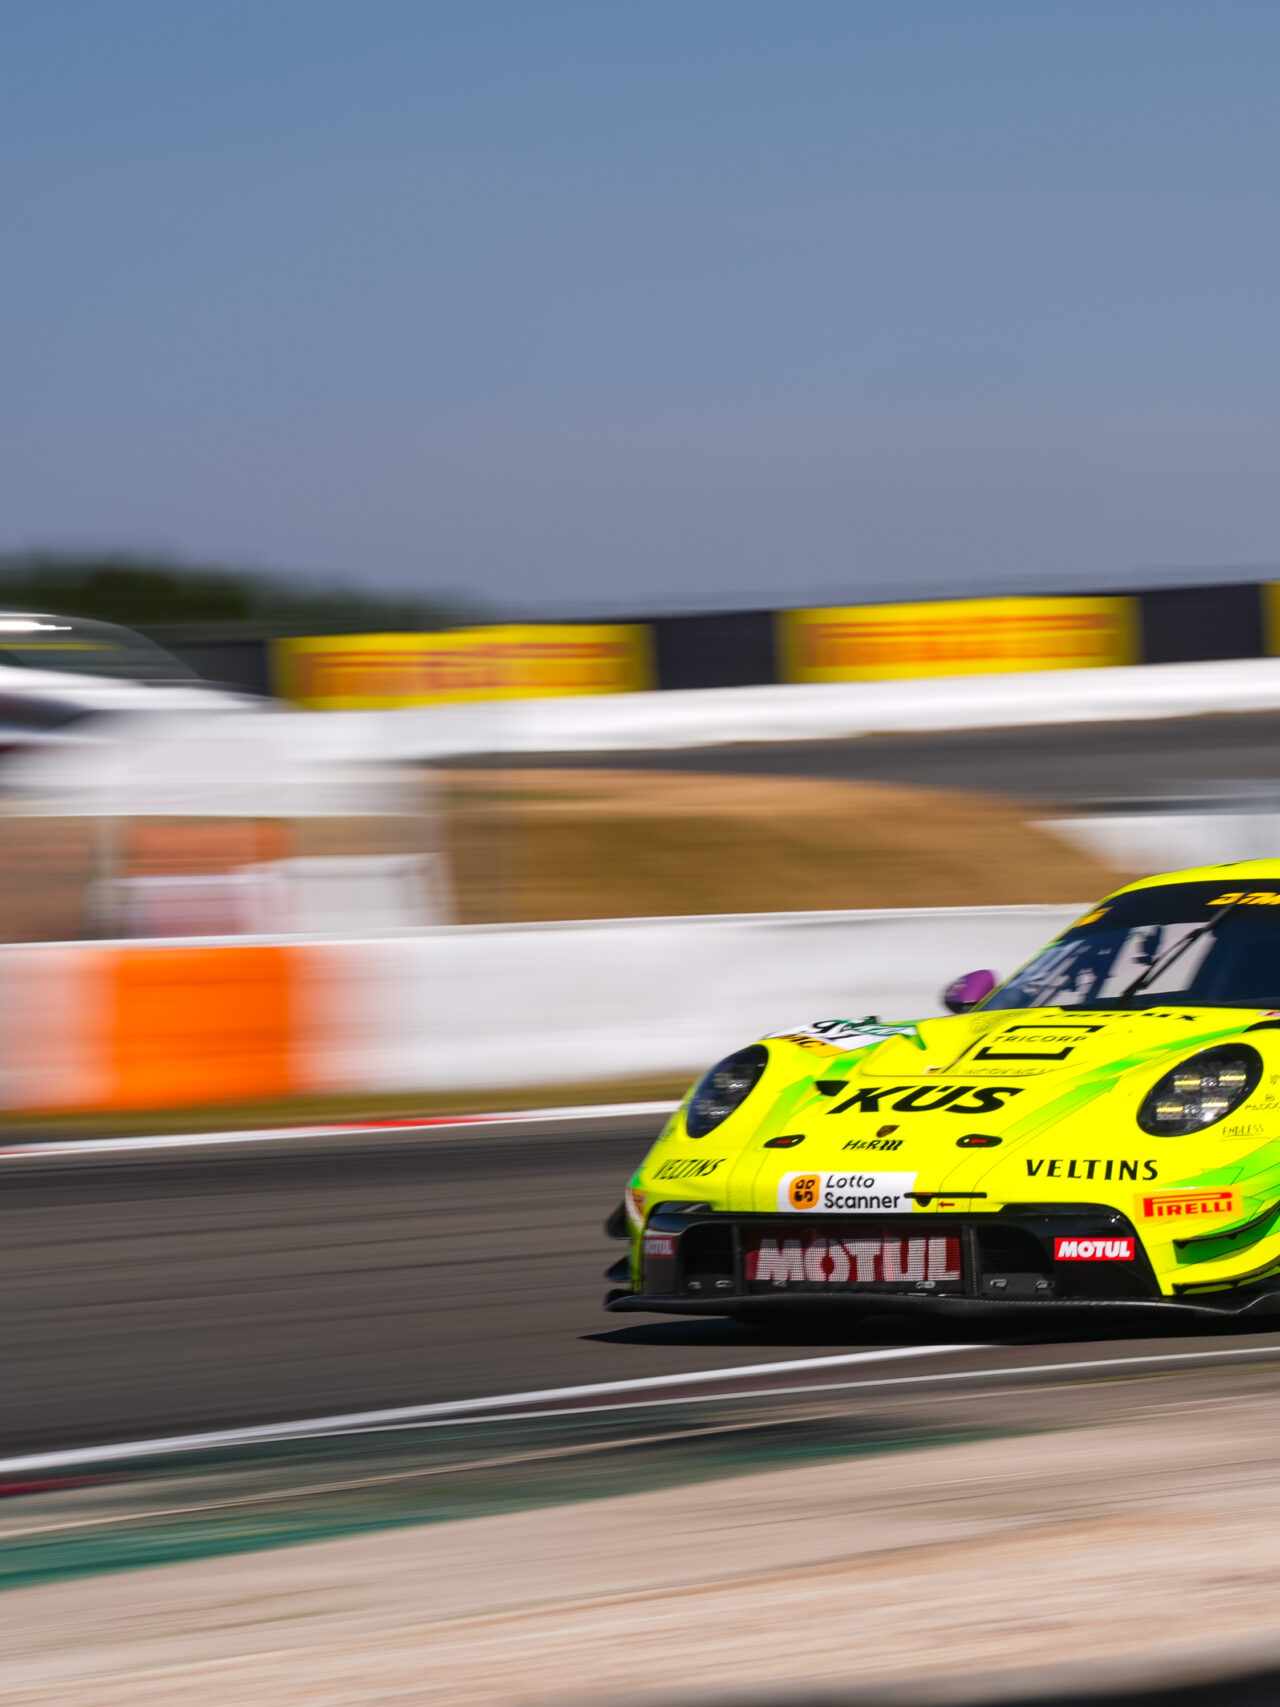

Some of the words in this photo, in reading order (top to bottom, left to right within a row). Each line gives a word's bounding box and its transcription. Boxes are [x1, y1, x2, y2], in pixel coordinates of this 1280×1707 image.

[992, 1035, 1088, 1043] TRICORP
[825, 1086, 1026, 1115] KÜS
[652, 1158, 728, 1180] VELTINS
[1026, 1159, 1158, 1181] VELTINS
[825, 1174, 875, 1188] Lotto
[824, 1192, 901, 1209] Scanner
[1143, 1191, 1233, 1217] PIRELLI
[754, 1236, 961, 1281] MOTUL
[1057, 1241, 1131, 1258] MOTUL
